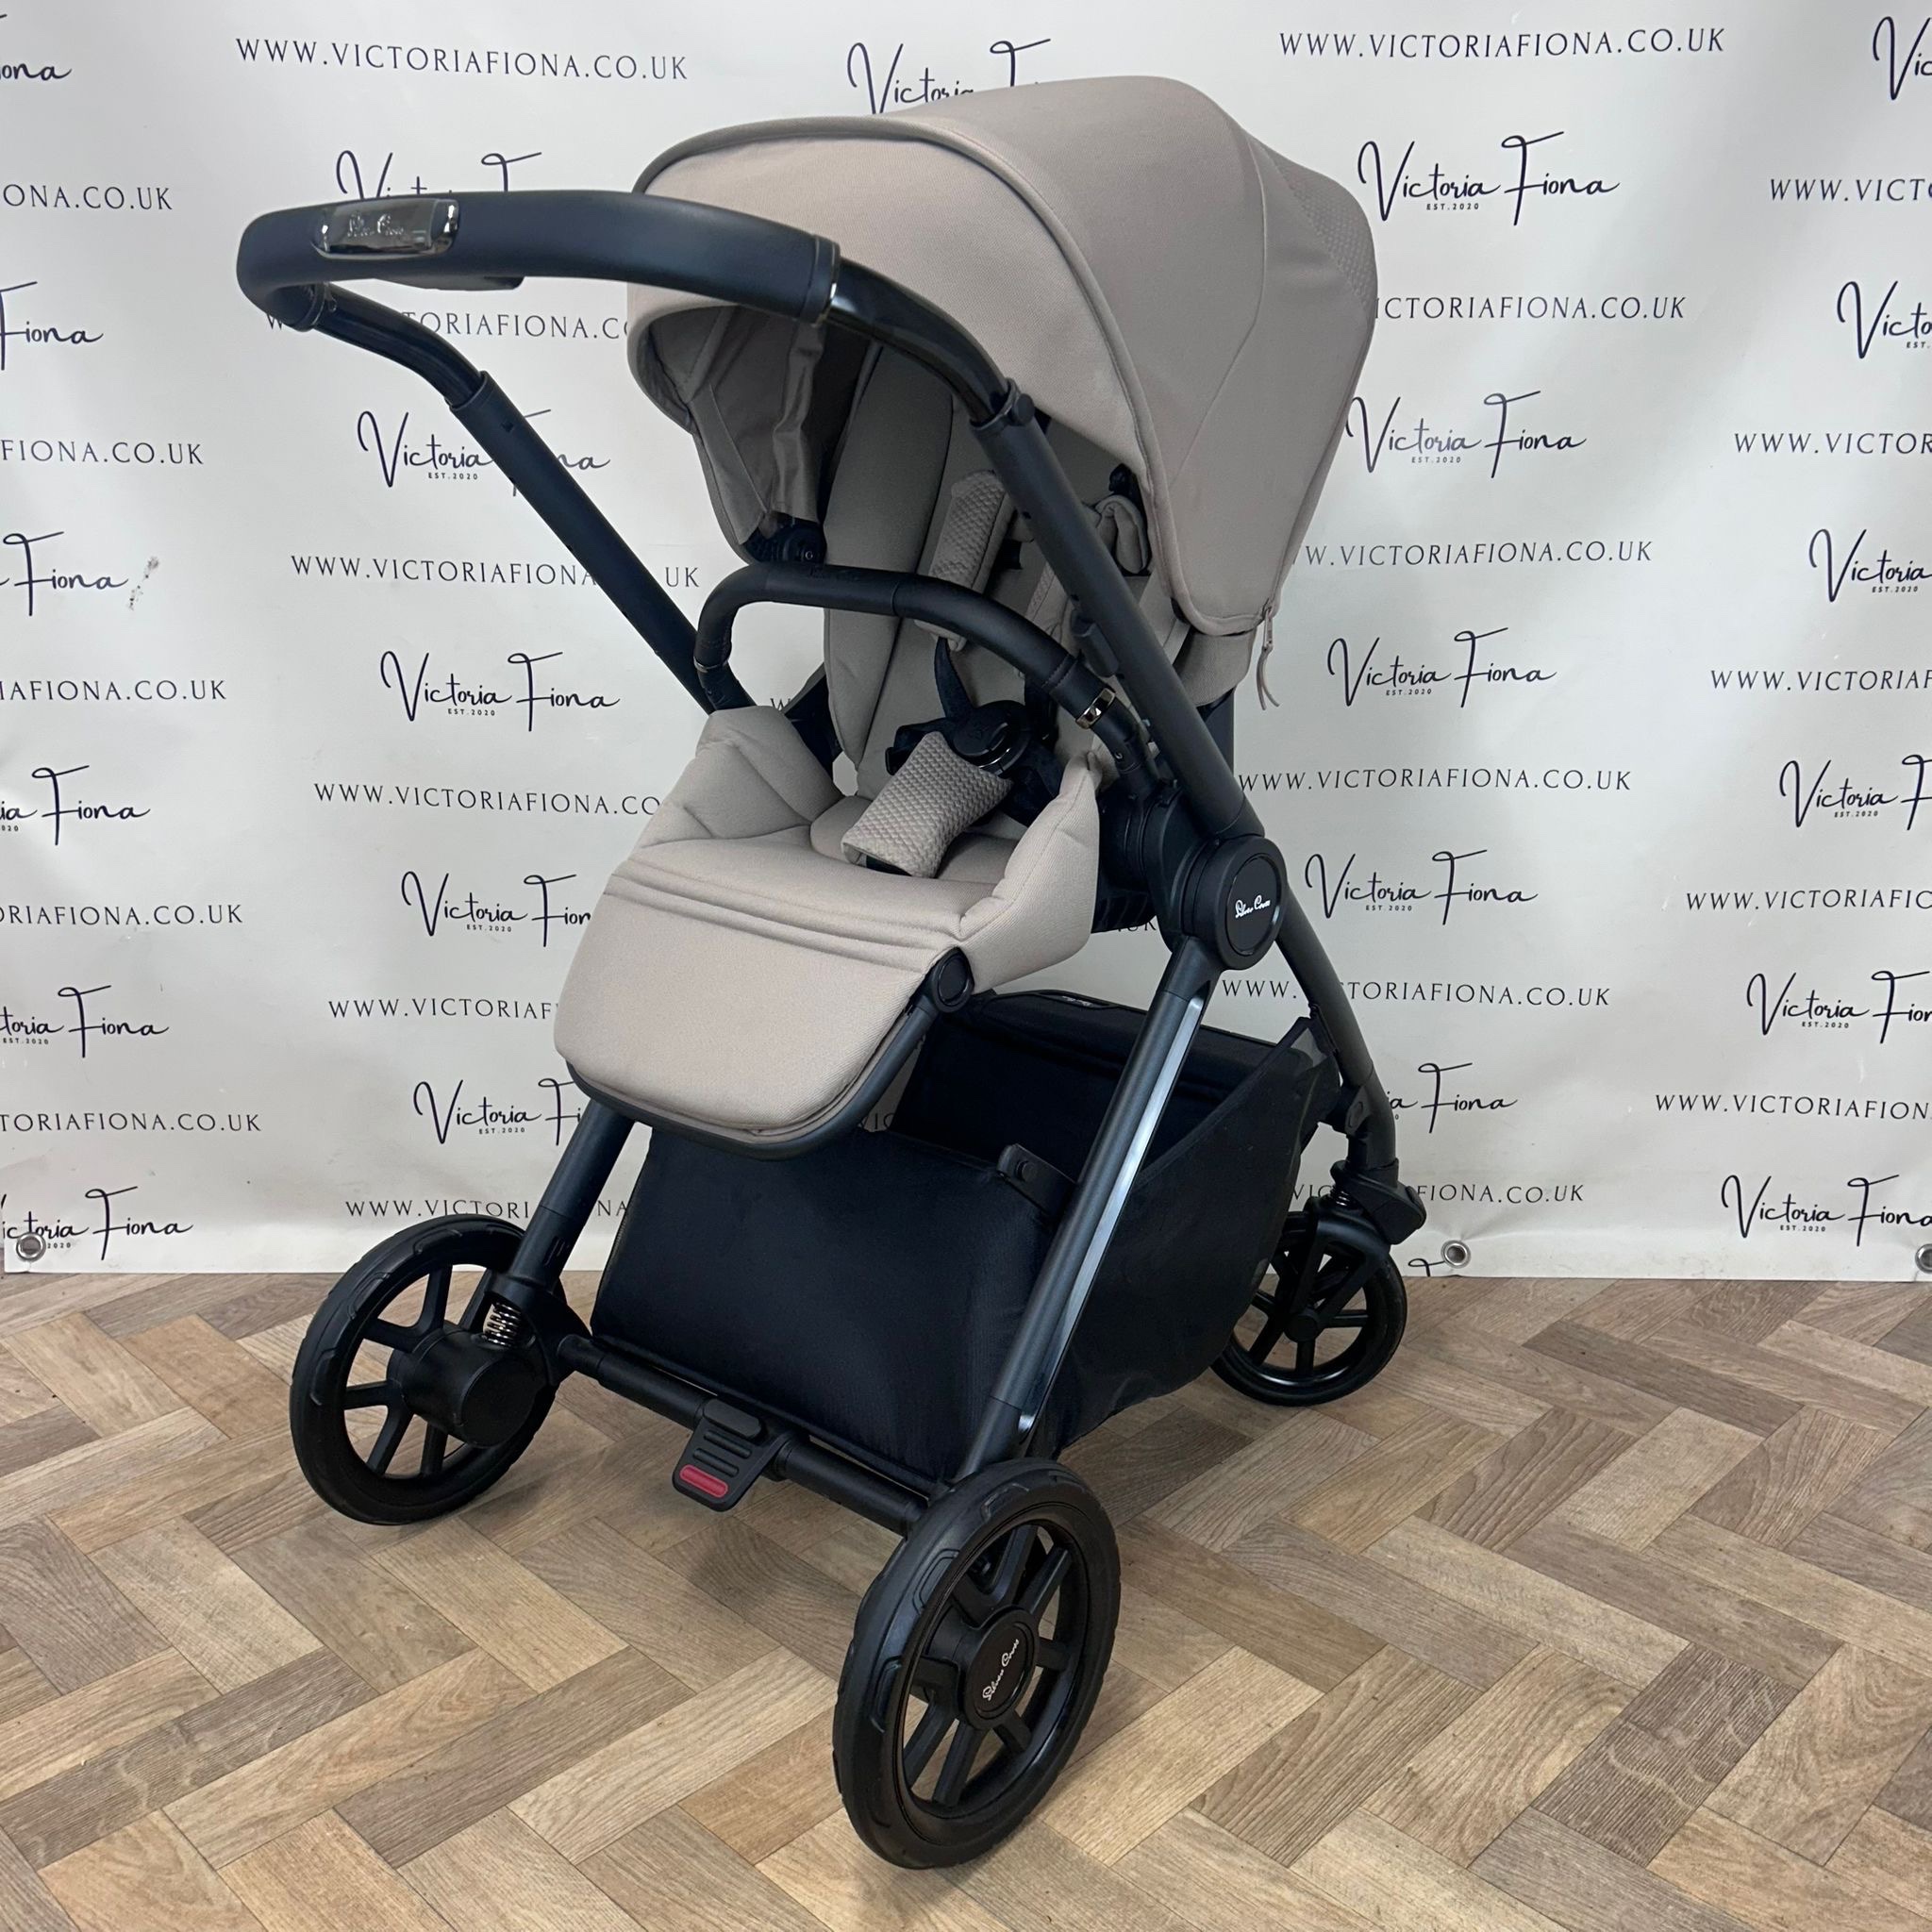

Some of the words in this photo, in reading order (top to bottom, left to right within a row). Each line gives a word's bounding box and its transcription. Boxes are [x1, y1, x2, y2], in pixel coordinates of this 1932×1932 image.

[236, 39, 687, 79] WWW.VICTORIAFIONA.CO.UK
[1280, 28, 1724, 58] WWW.VICTORIAFIONA.CO.UK
[1357, 141, 1502, 222] Victoria
[1501, 131, 1620, 225] Fiona
[1771, 178, 1932, 202] WWW.VICT
[1425, 202, 1479, 211] EST.2020
[358, 410, 492, 488] Victoria
[1346, 396, 1482, 473] Victoria
[1484, 391, 1587, 478] Fiona
[427, 472, 478, 480] EST.2020
[1411, 456, 1461, 464] EST.2020
[1293, 541, 1652, 566] W.VICTORIAFIONA.CO.UK
[1809, 529, 1932, 602] Victoria
[3, 531, 128, 616] Fiona
[1872, 585, 1919, 593] EST.2020
[1327, 637, 1452, 707] Victoria
[1454, 627, 1557, 708] Fiona
[380, 651, 510, 722] Victoria
[508, 652, 620, 732] Fiona
[1385, 688, 1432, 696] EST.2020
[447, 708, 495, 717] EST.2020
[1239, 768, 1631, 791] WWW.VICTORIAFIONA.CO.UK
[1779, 759, 1898, 827] Victoria
[31, 765, 150, 845] Fiona
[1834, 809, 1879, 819] EST.2020
[401, 871, 528, 937] Victoria
[1305, 853, 1431, 919] Victoria
[1432, 850, 1538, 925] Fiona
[0, 905, 243, 926] RIAFIONA.CO.UK
[1365, 904, 1412, 912] EST.2020
[466, 924, 512, 933] EST.2020
[58, 985, 169, 1058] Fiona
[328, 998, 558, 1020] WWW.VICTORIAF
[1746, 973, 1871, 1036] Victoria
[1801, 1021, 1850, 1029] EST.2020
[413, 1079, 541, 1144] Victoria
[1418, 1063, 1518, 1134] Fiona
[1656, 1094, 1932, 1120] WWW.VICTORIAFION
[1, 1193, 90, 1240] ictoria
[85, 1186, 193, 1260] Fiona
[1721, 1174, 1845, 1238] Victoria
[1779, 1224, 1826, 1233] EST.2020
